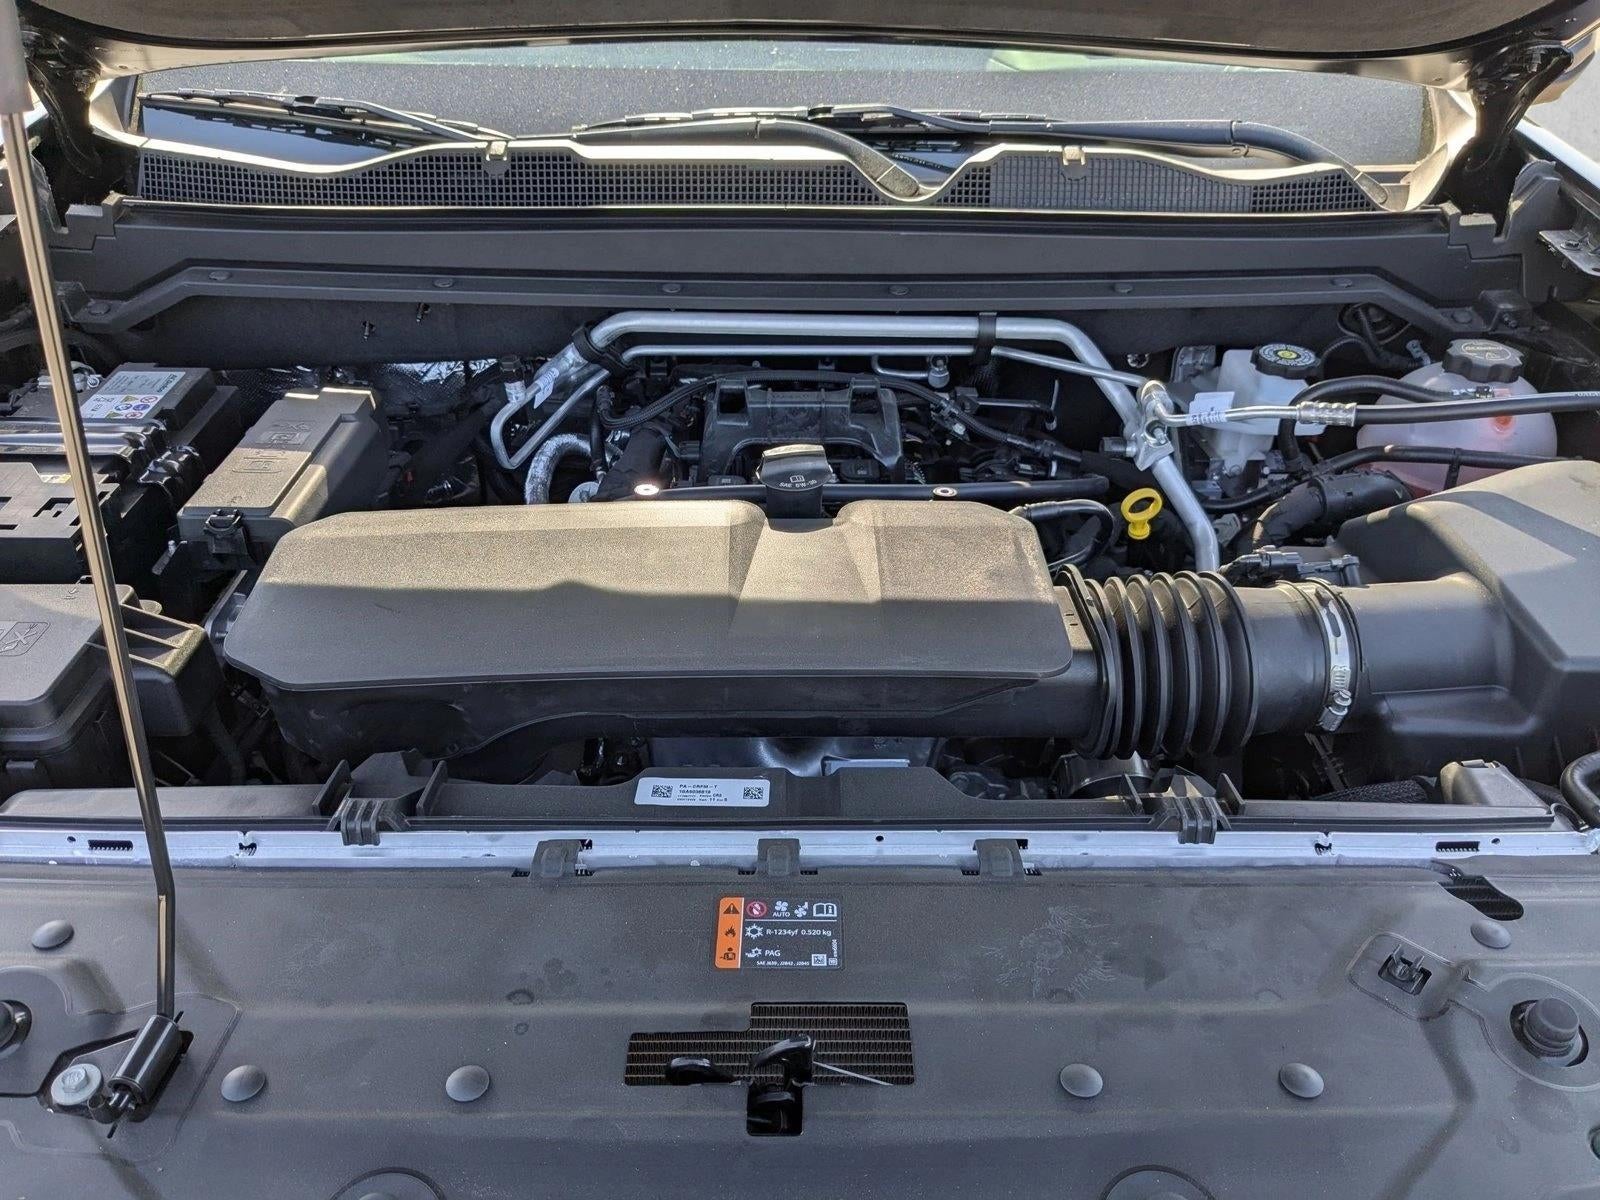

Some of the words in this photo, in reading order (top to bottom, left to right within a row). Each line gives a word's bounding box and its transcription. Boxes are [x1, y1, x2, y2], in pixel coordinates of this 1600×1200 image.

[766, 928, 799, 937] R-1234yf
[822, 929, 832, 937] kg
[764, 949, 781, 957] PAG
